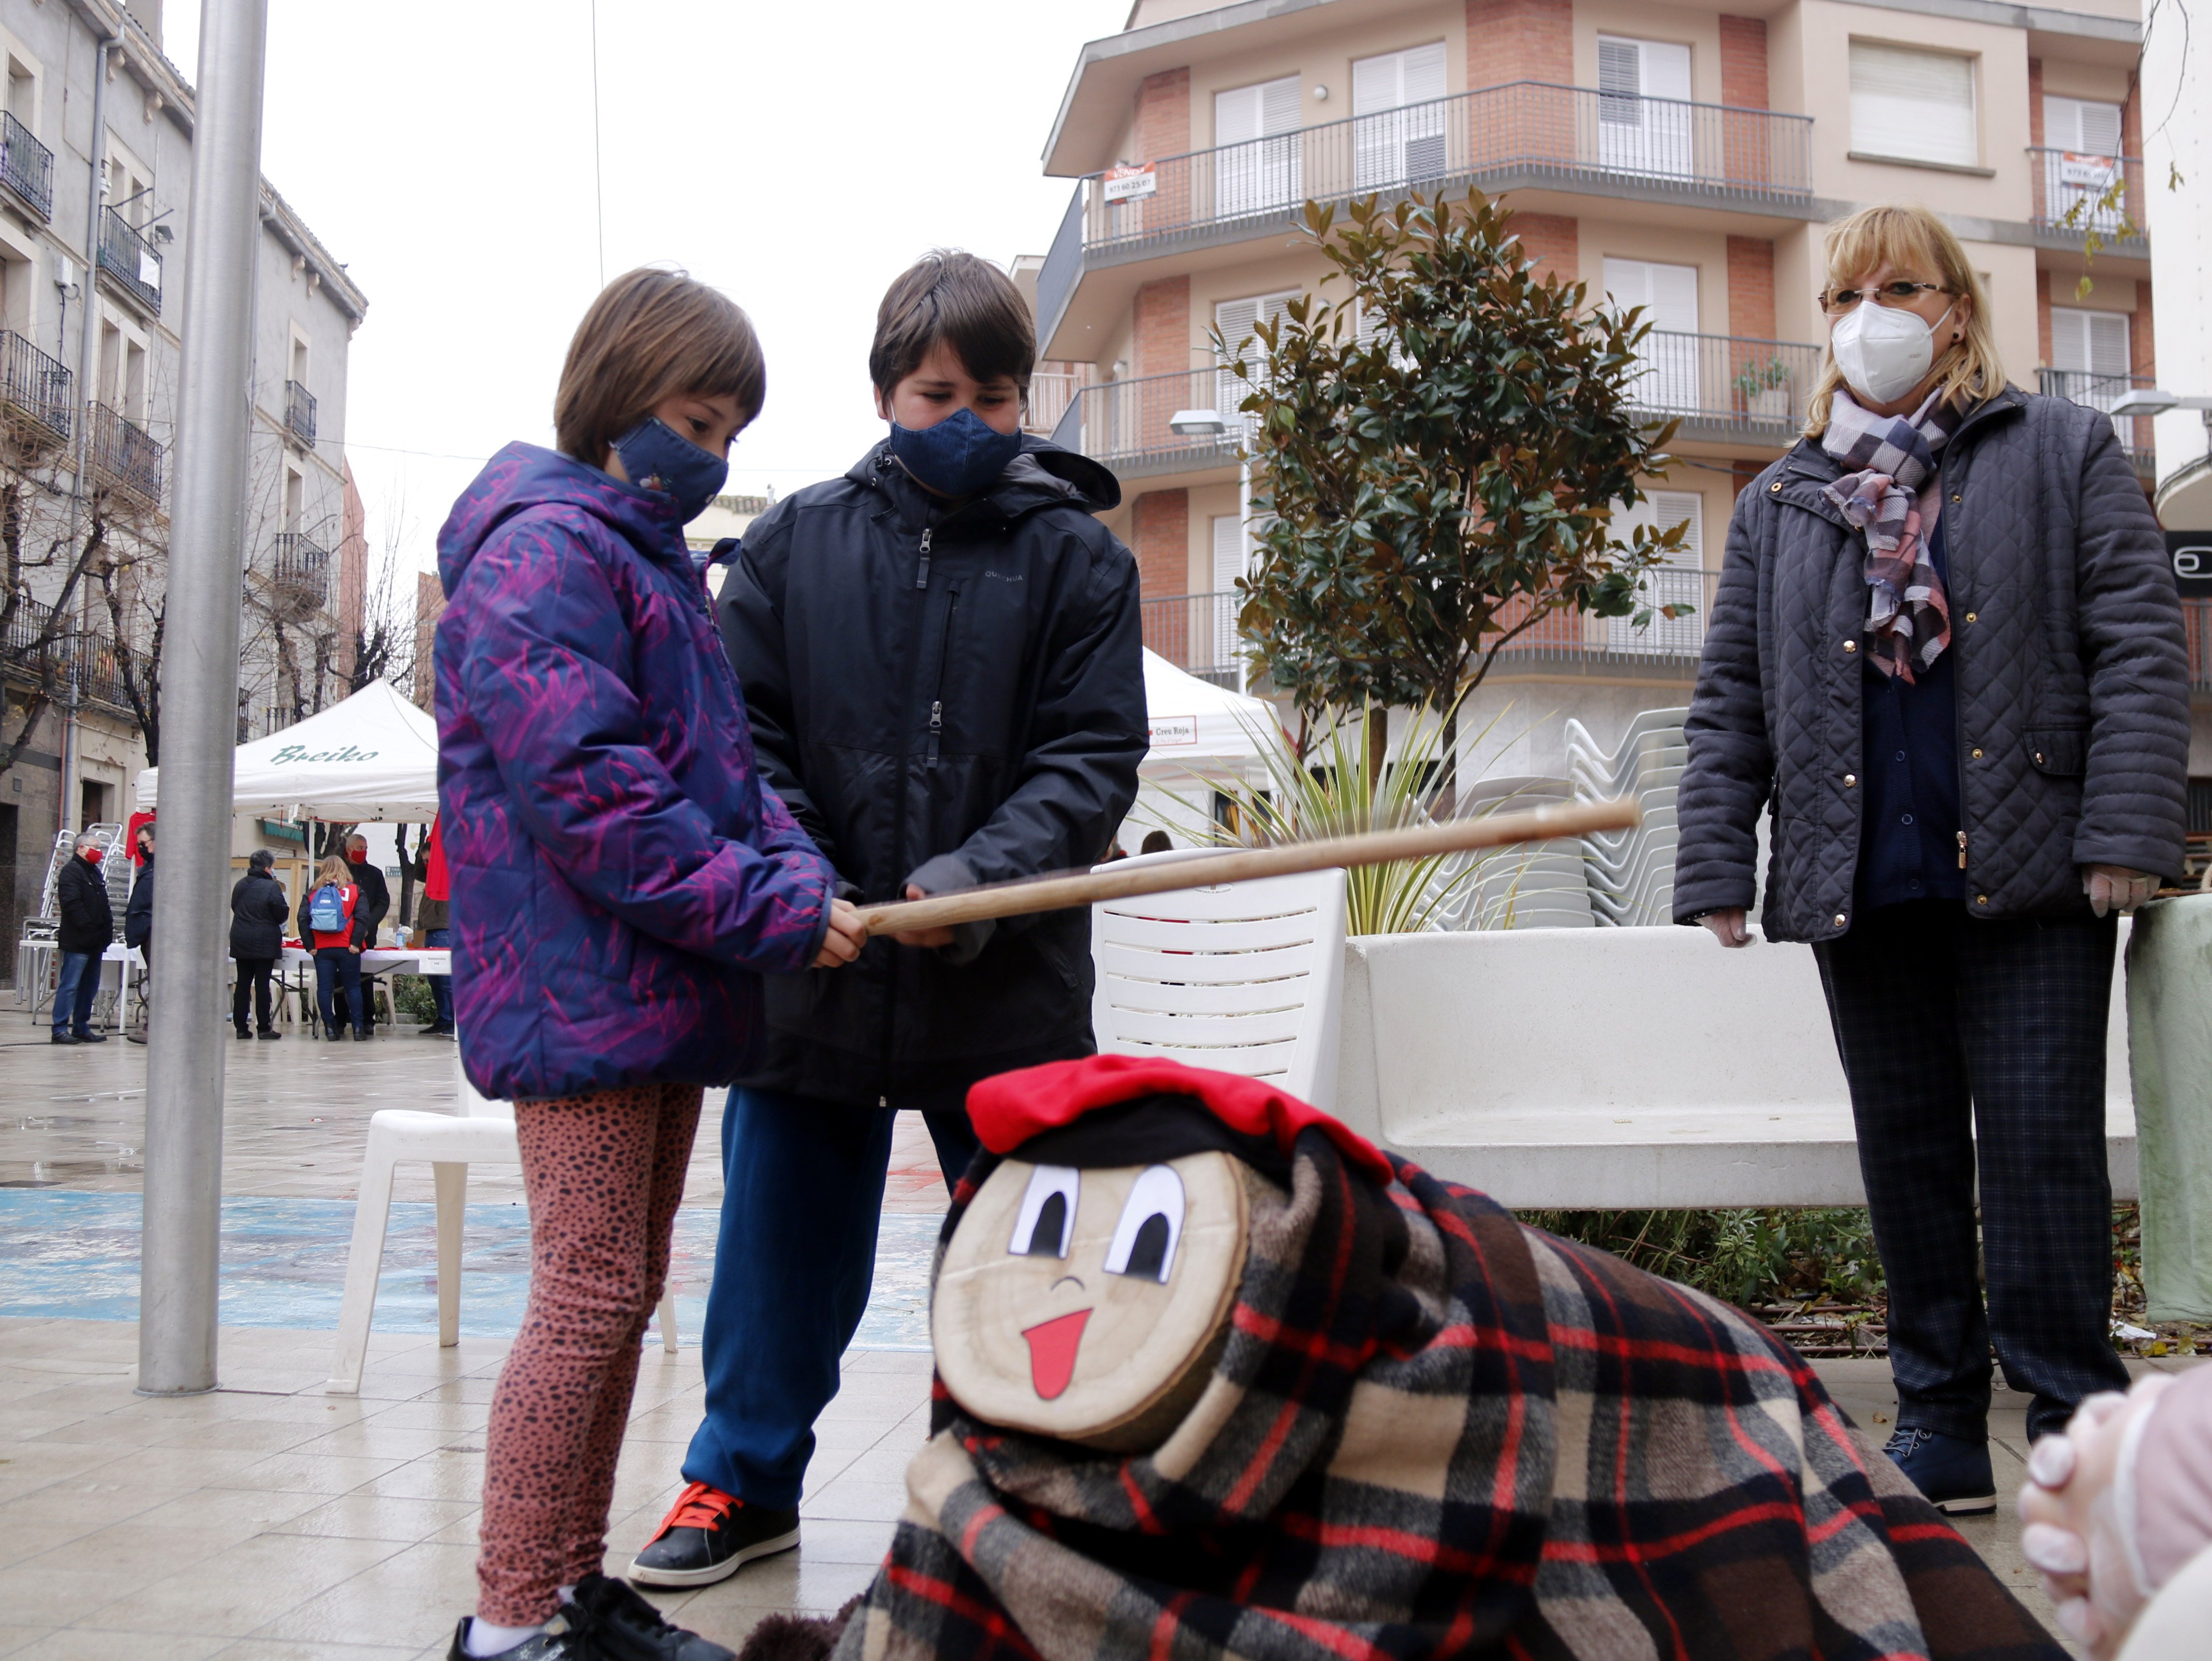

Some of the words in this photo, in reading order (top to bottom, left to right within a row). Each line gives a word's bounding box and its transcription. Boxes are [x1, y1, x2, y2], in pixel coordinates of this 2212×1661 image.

[1114, 168, 1144, 178] VENDA
[985, 571, 1023, 582] QUECHUA
[1174, 726, 1189, 736] Roja
[270, 745, 379, 765] Breiko
